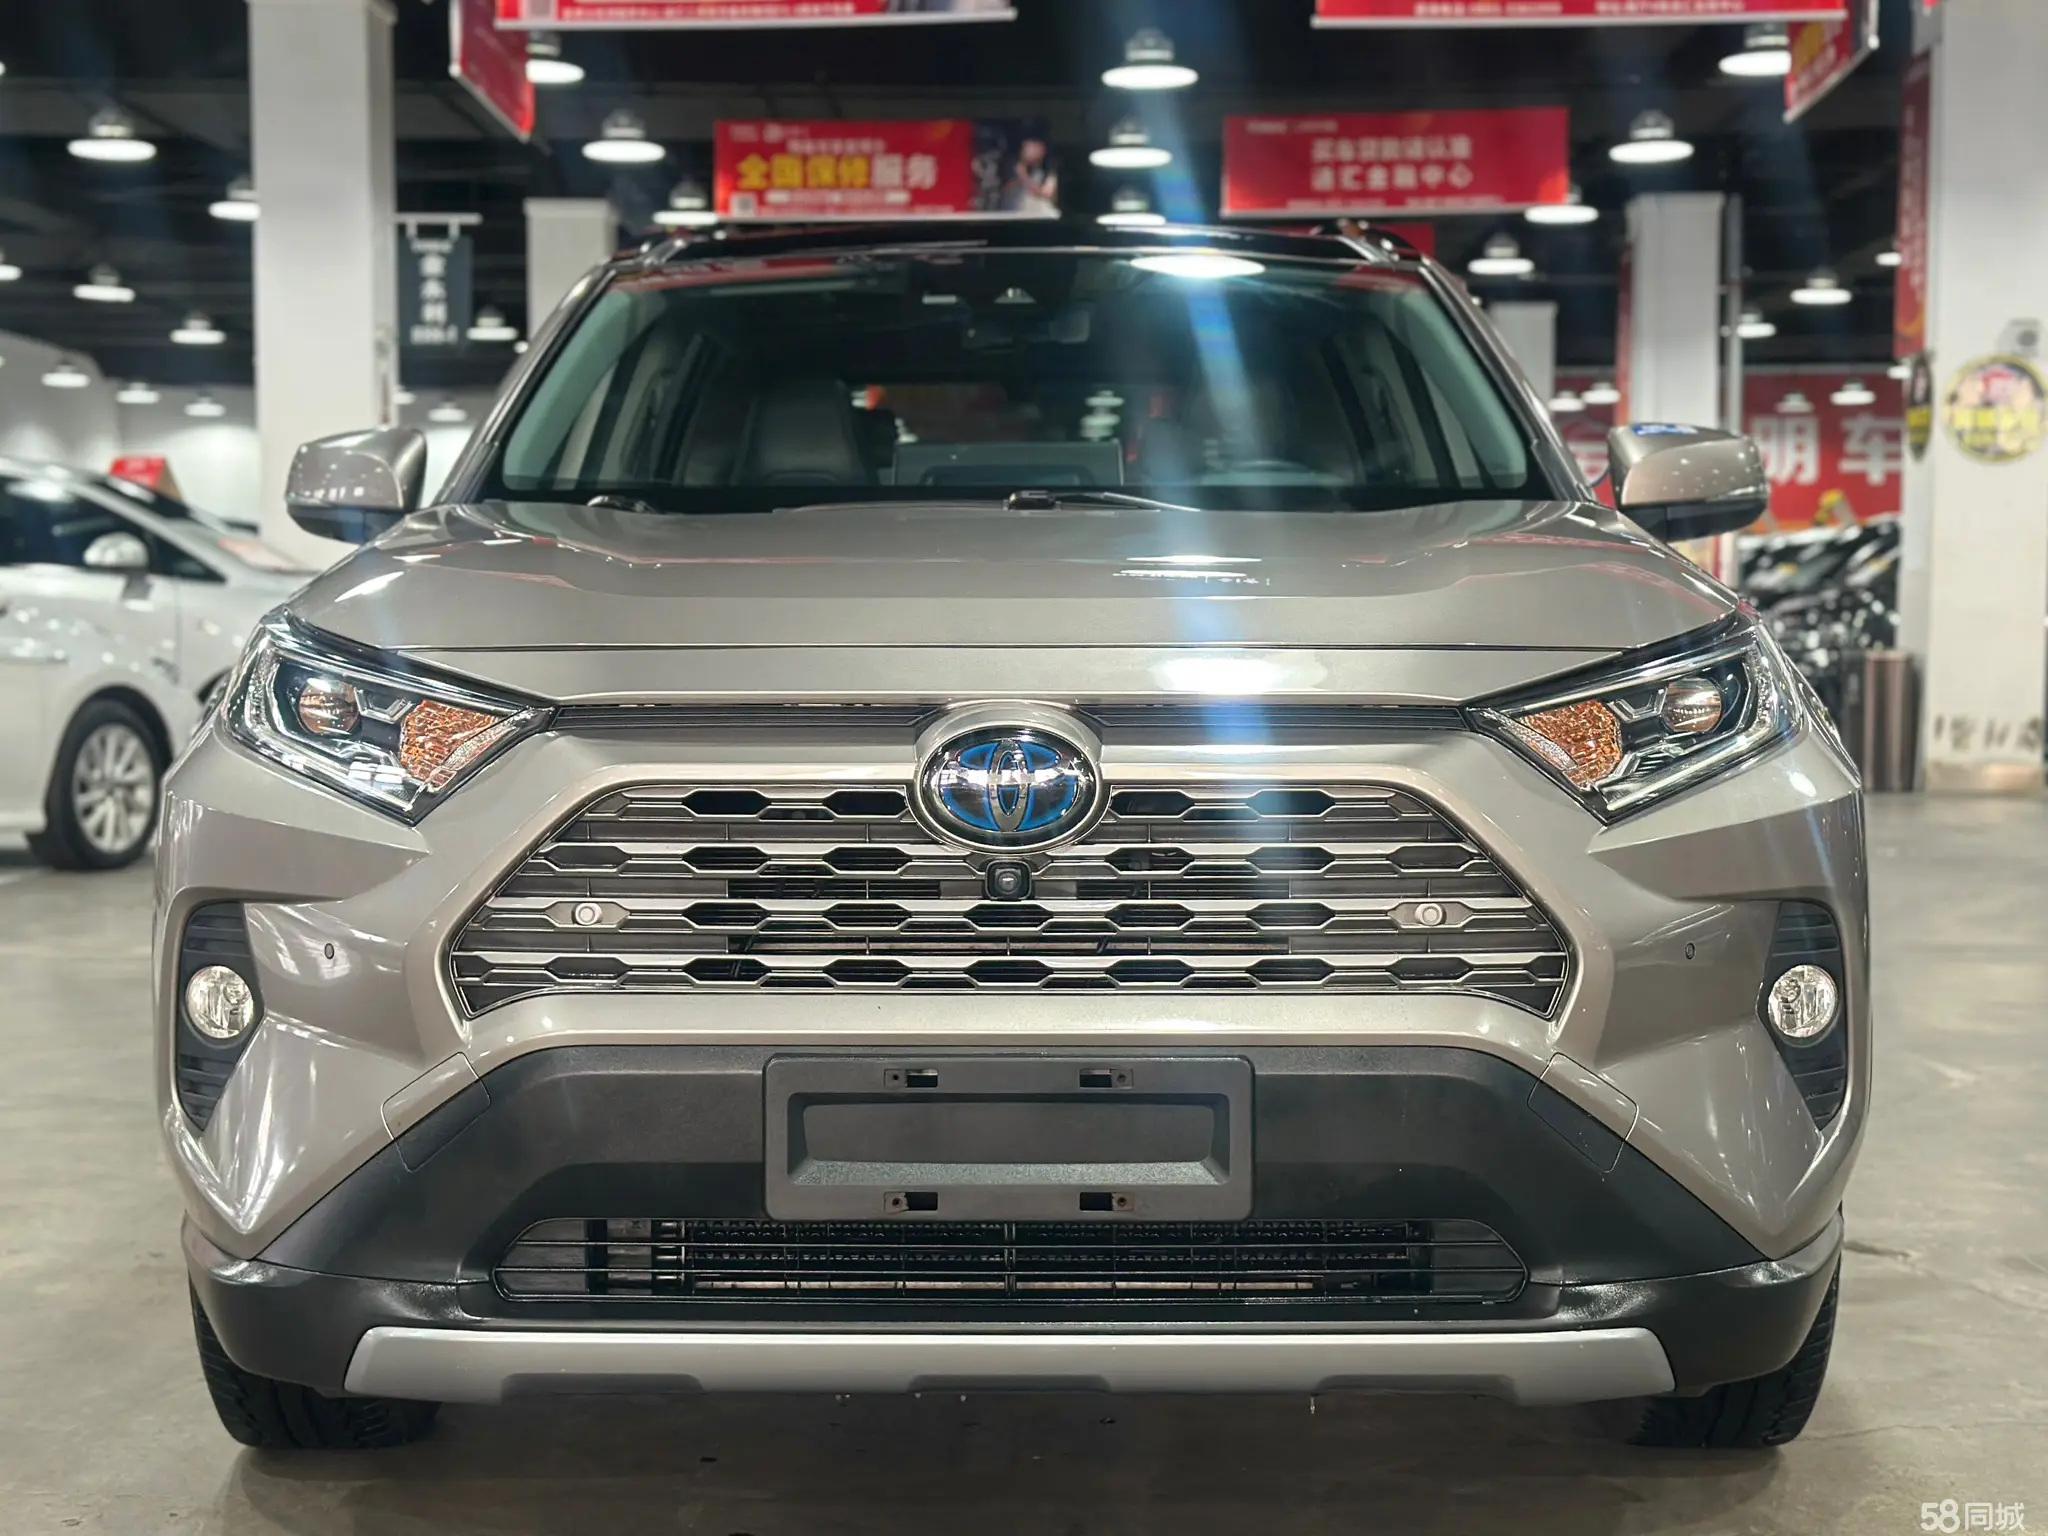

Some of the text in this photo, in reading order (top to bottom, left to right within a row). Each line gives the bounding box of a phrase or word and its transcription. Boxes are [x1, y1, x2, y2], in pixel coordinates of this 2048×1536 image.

[736, 152, 938, 191] 全国保修服务
